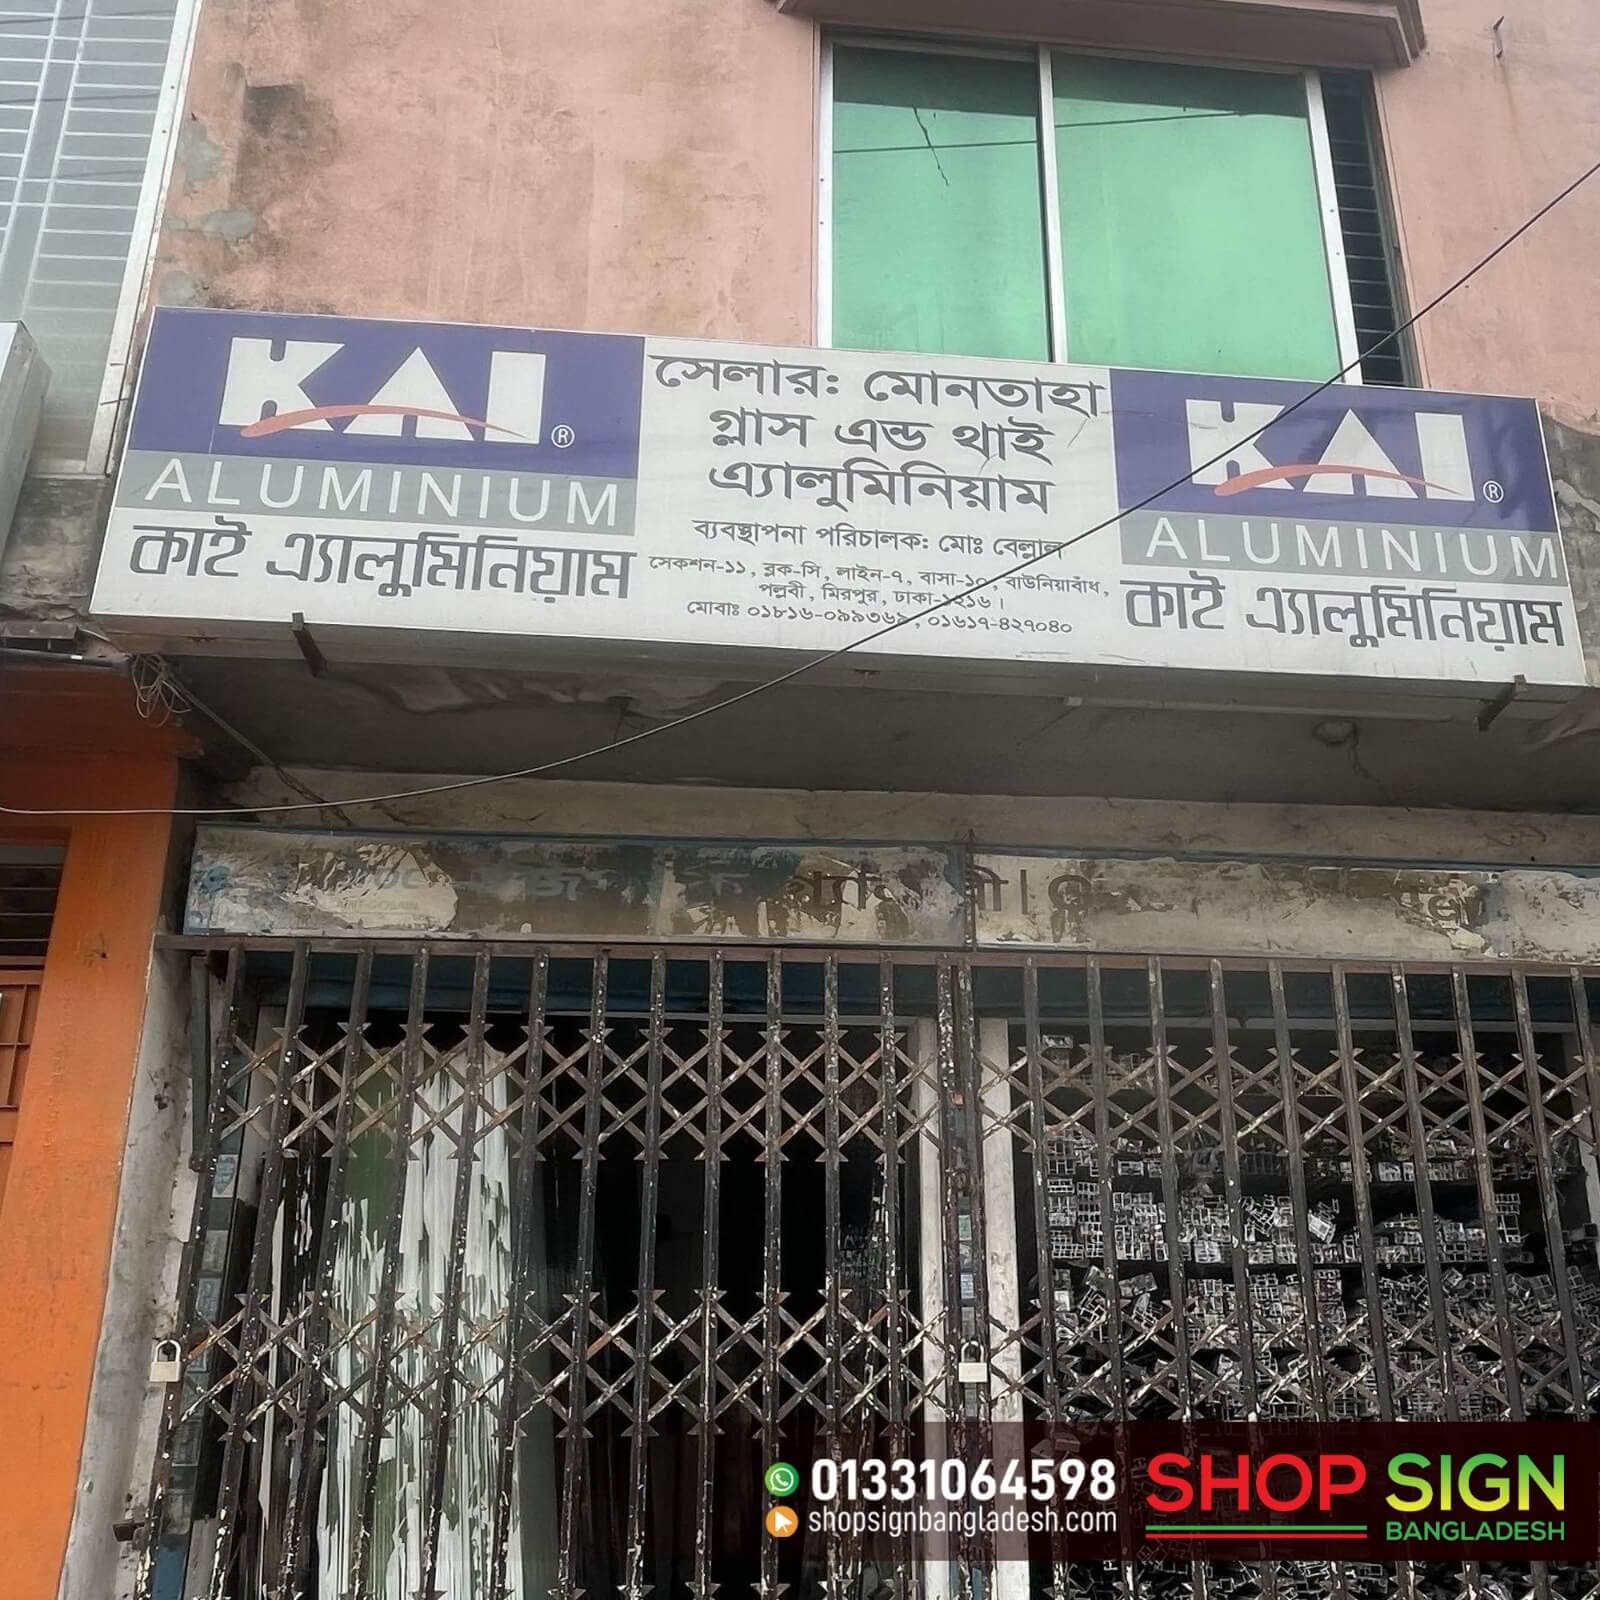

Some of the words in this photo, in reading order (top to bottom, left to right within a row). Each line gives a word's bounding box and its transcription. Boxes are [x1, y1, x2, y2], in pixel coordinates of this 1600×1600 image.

[218, 336, 546, 445] KAI
[864, 370, 1105, 417] মোনতাহা
[709, 407, 816, 447] গ্লাস
[834, 418, 935, 452] এন্ড
[952, 416, 1057, 465] থাই
[1186, 399, 1475, 502] KAI
[145, 457, 618, 527] ALUMINIUM
[129, 515, 252, 577] কাই
[691, 520, 807, 546] ব্যবস্থাপনা
[938, 534, 984, 555] মোঃ
[1146, 517, 1558, 579] ALUMINIUM
[928, 614, 1073, 634] ০১৬১৭-৪২৭০৪০
[1119, 570, 1226, 631] কাই
